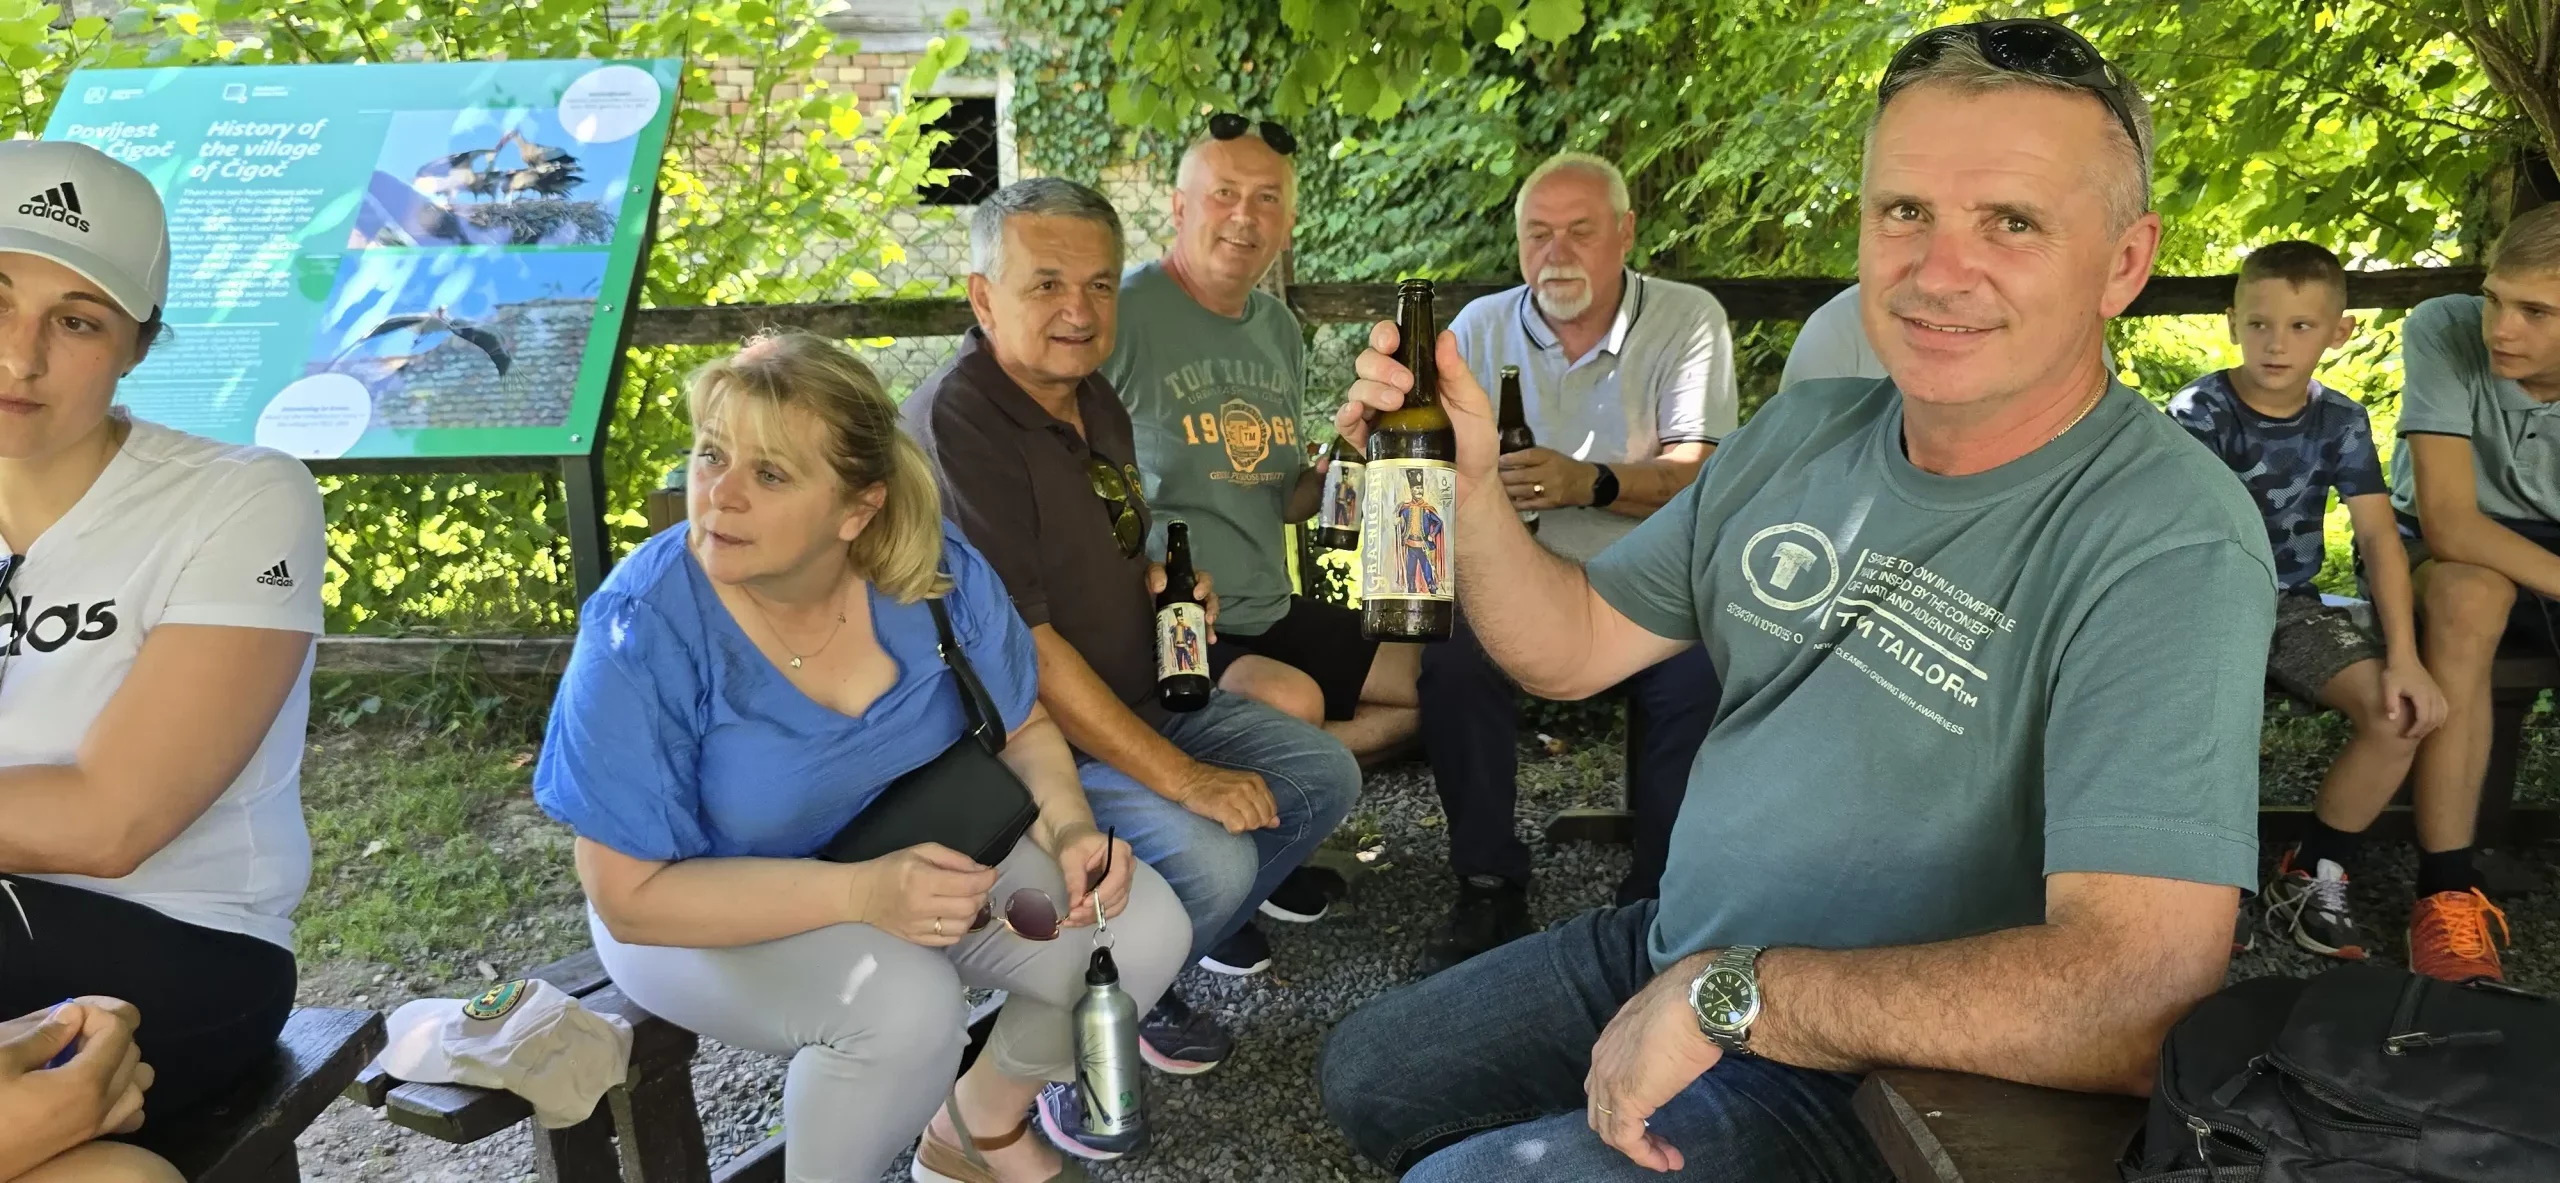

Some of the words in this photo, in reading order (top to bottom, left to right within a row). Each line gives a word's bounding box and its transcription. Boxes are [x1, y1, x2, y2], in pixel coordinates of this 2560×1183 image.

[64, 121, 160, 141] Povijest
[206, 120, 297, 138] History
[296, 117, 329, 138] of
[105, 138, 177, 161] Čigoč
[199, 141, 240, 157] the
[244, 141, 322, 161] village
[190, 160, 220, 182] of
[220, 158, 289, 182] Čigoč
[18, 202, 90, 233] adidas
[1164, 359, 1214, 399] TOM
[1183, 412, 1219, 445] 19
[256, 576, 293, 587] adidas
[1898, 559, 1914, 573] TO
[1934, 577, 1949, 591] IN
[1943, 584, 1955, 597] A
[1848, 580, 1863, 592] OF
[1886, 592, 1914, 612] AND
[1911, 584, 1931, 600] BY
[1927, 593, 1949, 613] THE
[1877, 626, 1965, 699] TAILOR
[1813, 642, 1833, 650] NEW
[1898, 690, 1917, 708] WITH
[1915, 704, 1965, 736] AWARENESS
